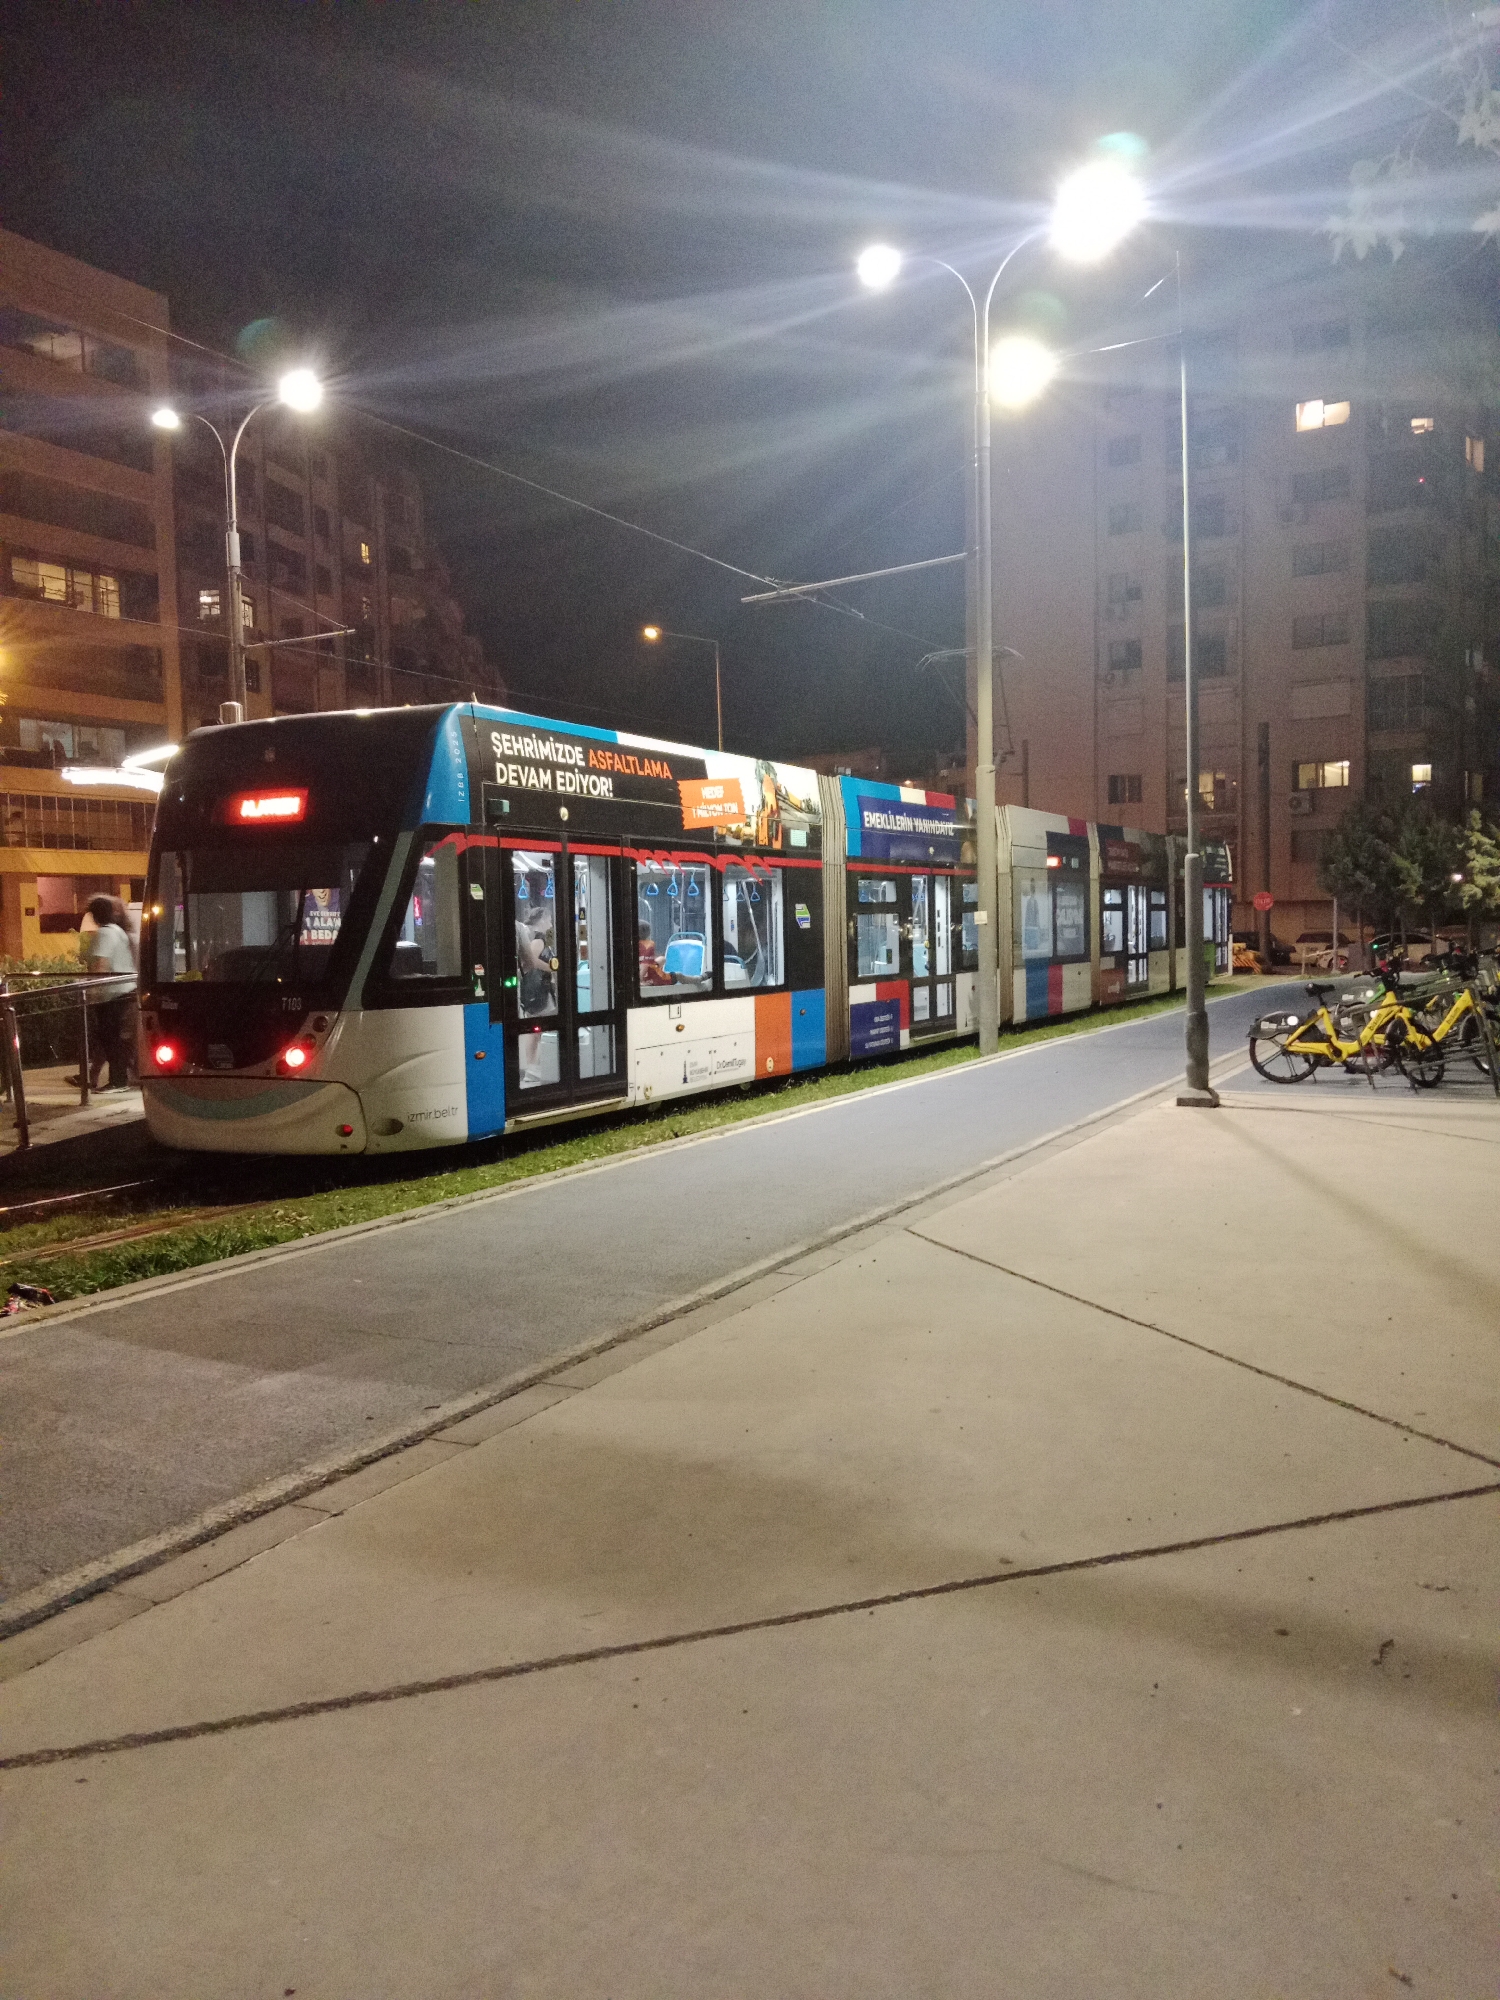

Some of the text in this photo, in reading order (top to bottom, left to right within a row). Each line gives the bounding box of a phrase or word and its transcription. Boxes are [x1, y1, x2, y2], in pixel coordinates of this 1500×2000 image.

[451, 731, 462, 763] 2025
[490, 731, 673, 780] ŞEHRİMİZDE ASFALTLAMA
[495, 762, 614, 798] DEVAM EDİYOR!
[863, 810, 913, 832] EMEKLİLERİN
